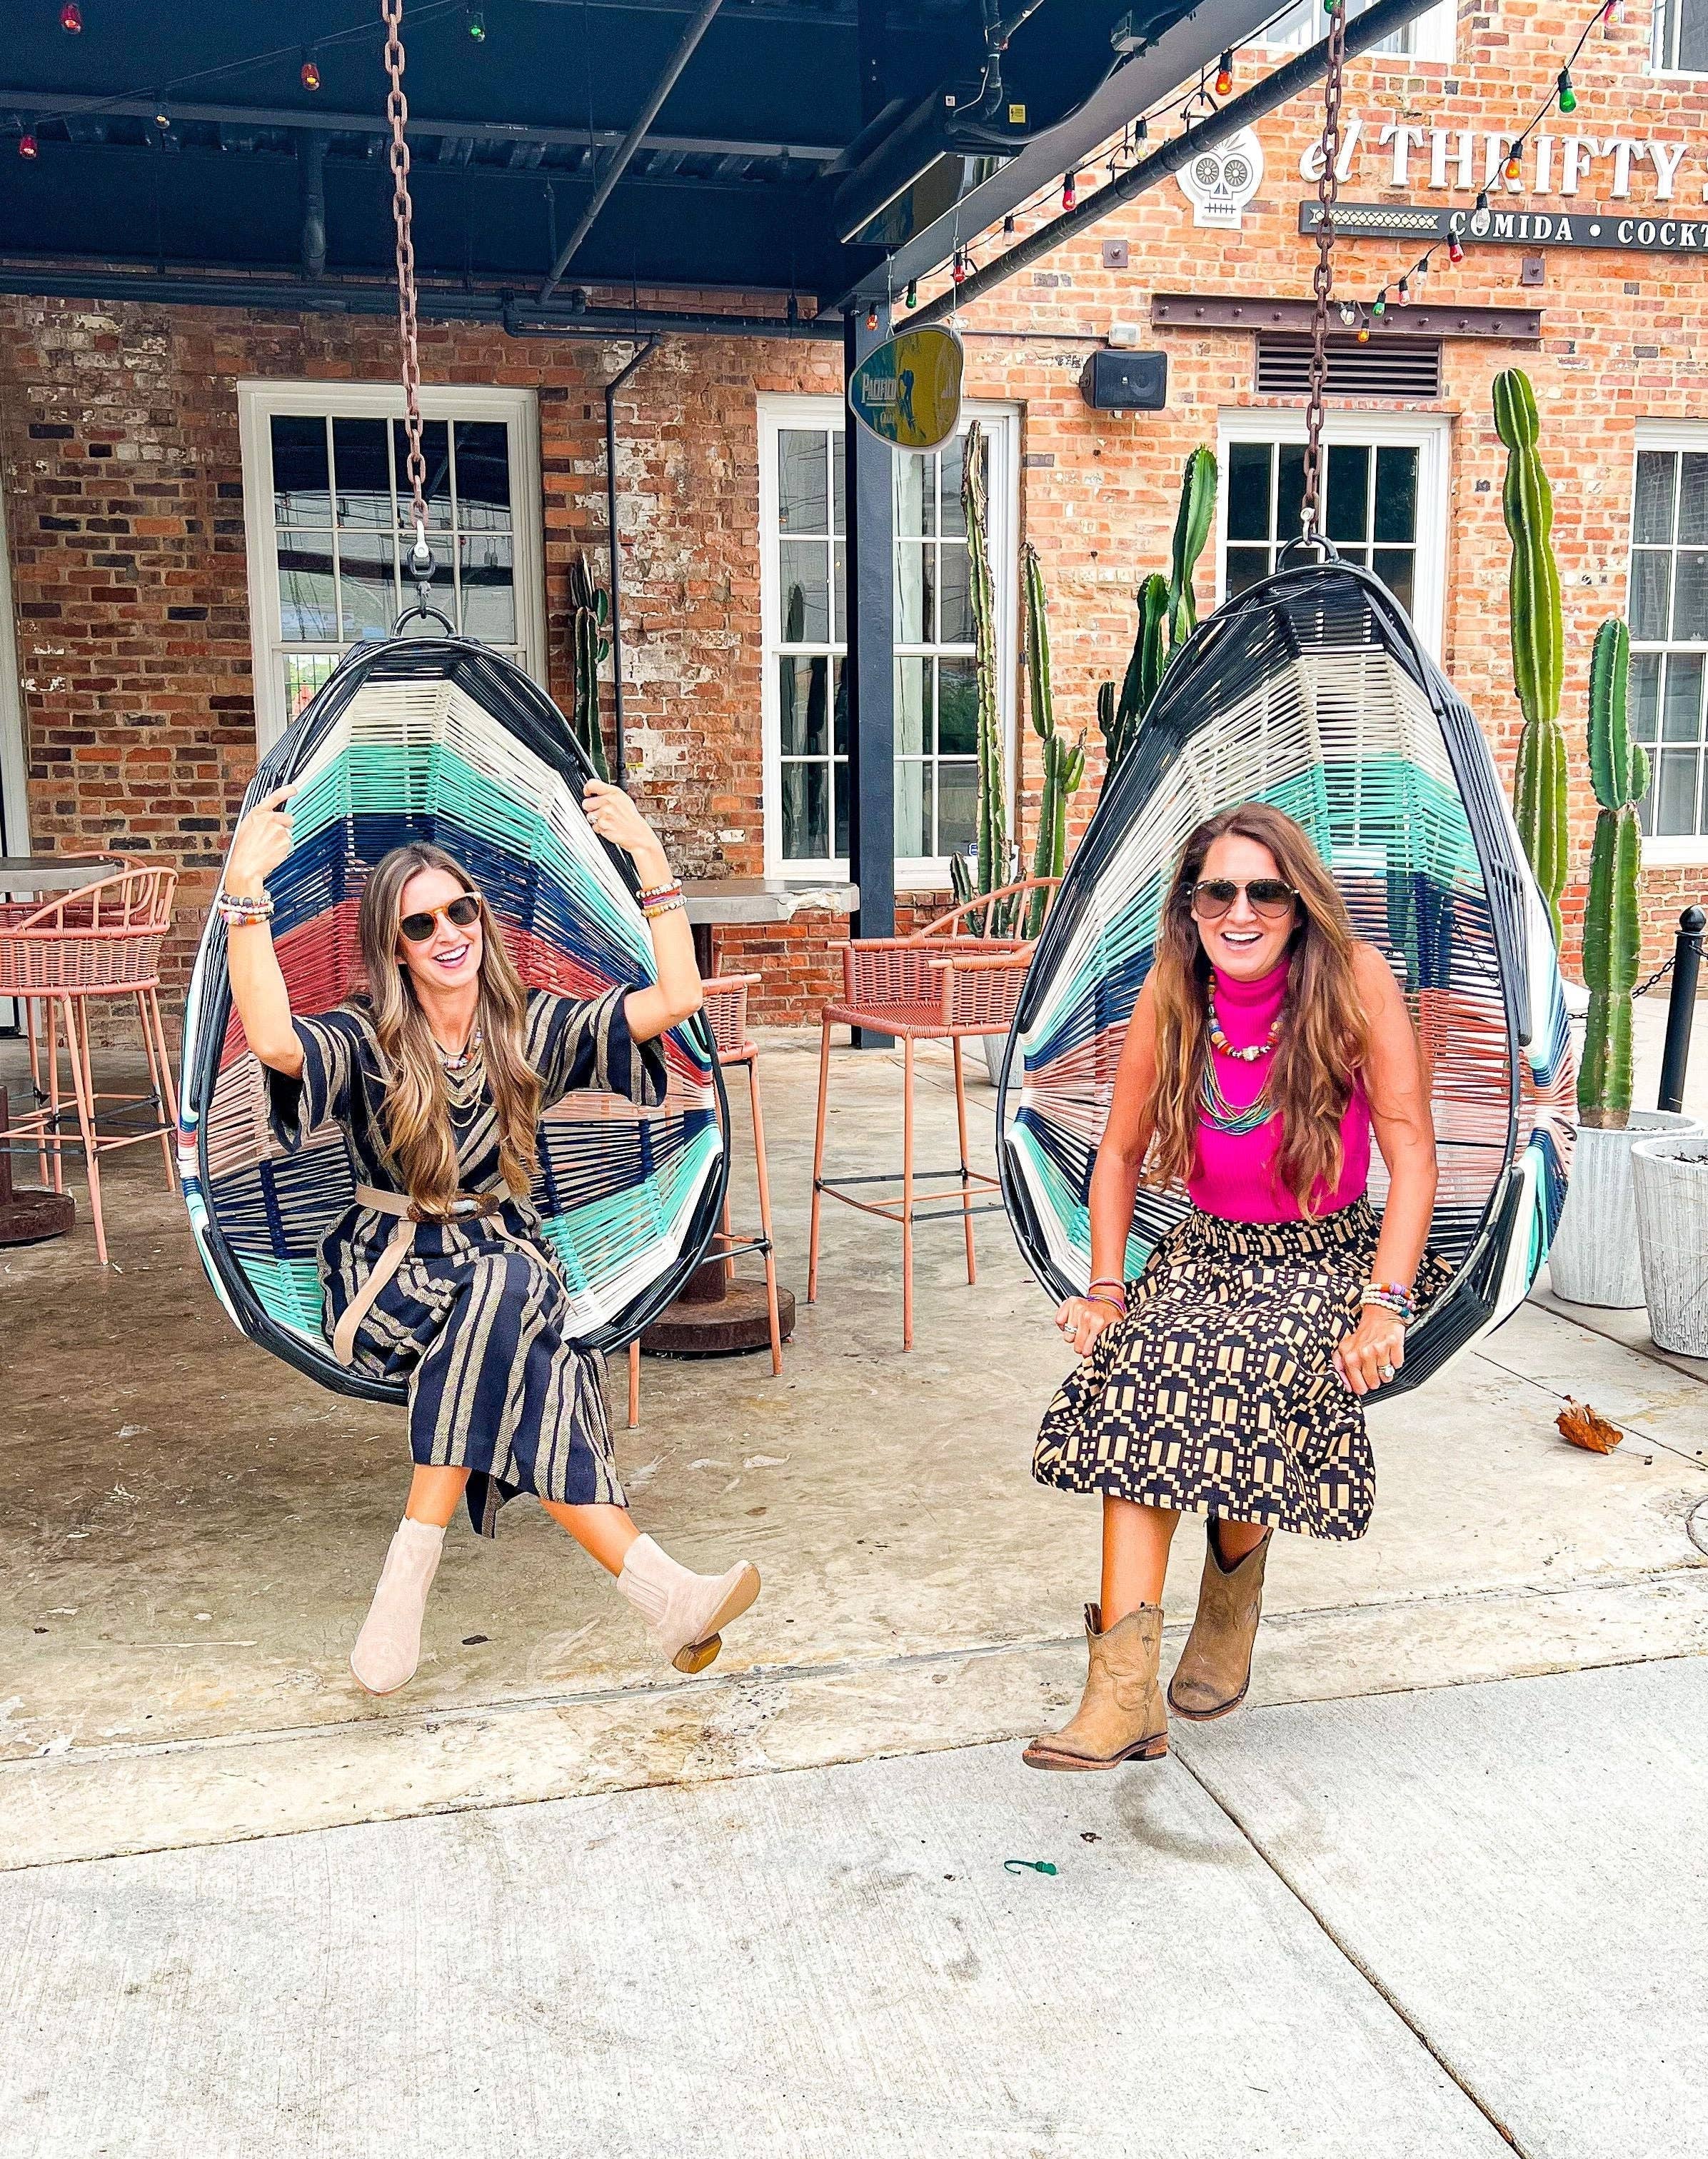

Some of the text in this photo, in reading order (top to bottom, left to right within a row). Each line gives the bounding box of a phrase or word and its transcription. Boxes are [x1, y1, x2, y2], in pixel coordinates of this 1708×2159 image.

[1298, 119, 1365, 184] el
[1377, 124, 1690, 201] THRIFTY
[1449, 211, 1573, 241] COMIDA
